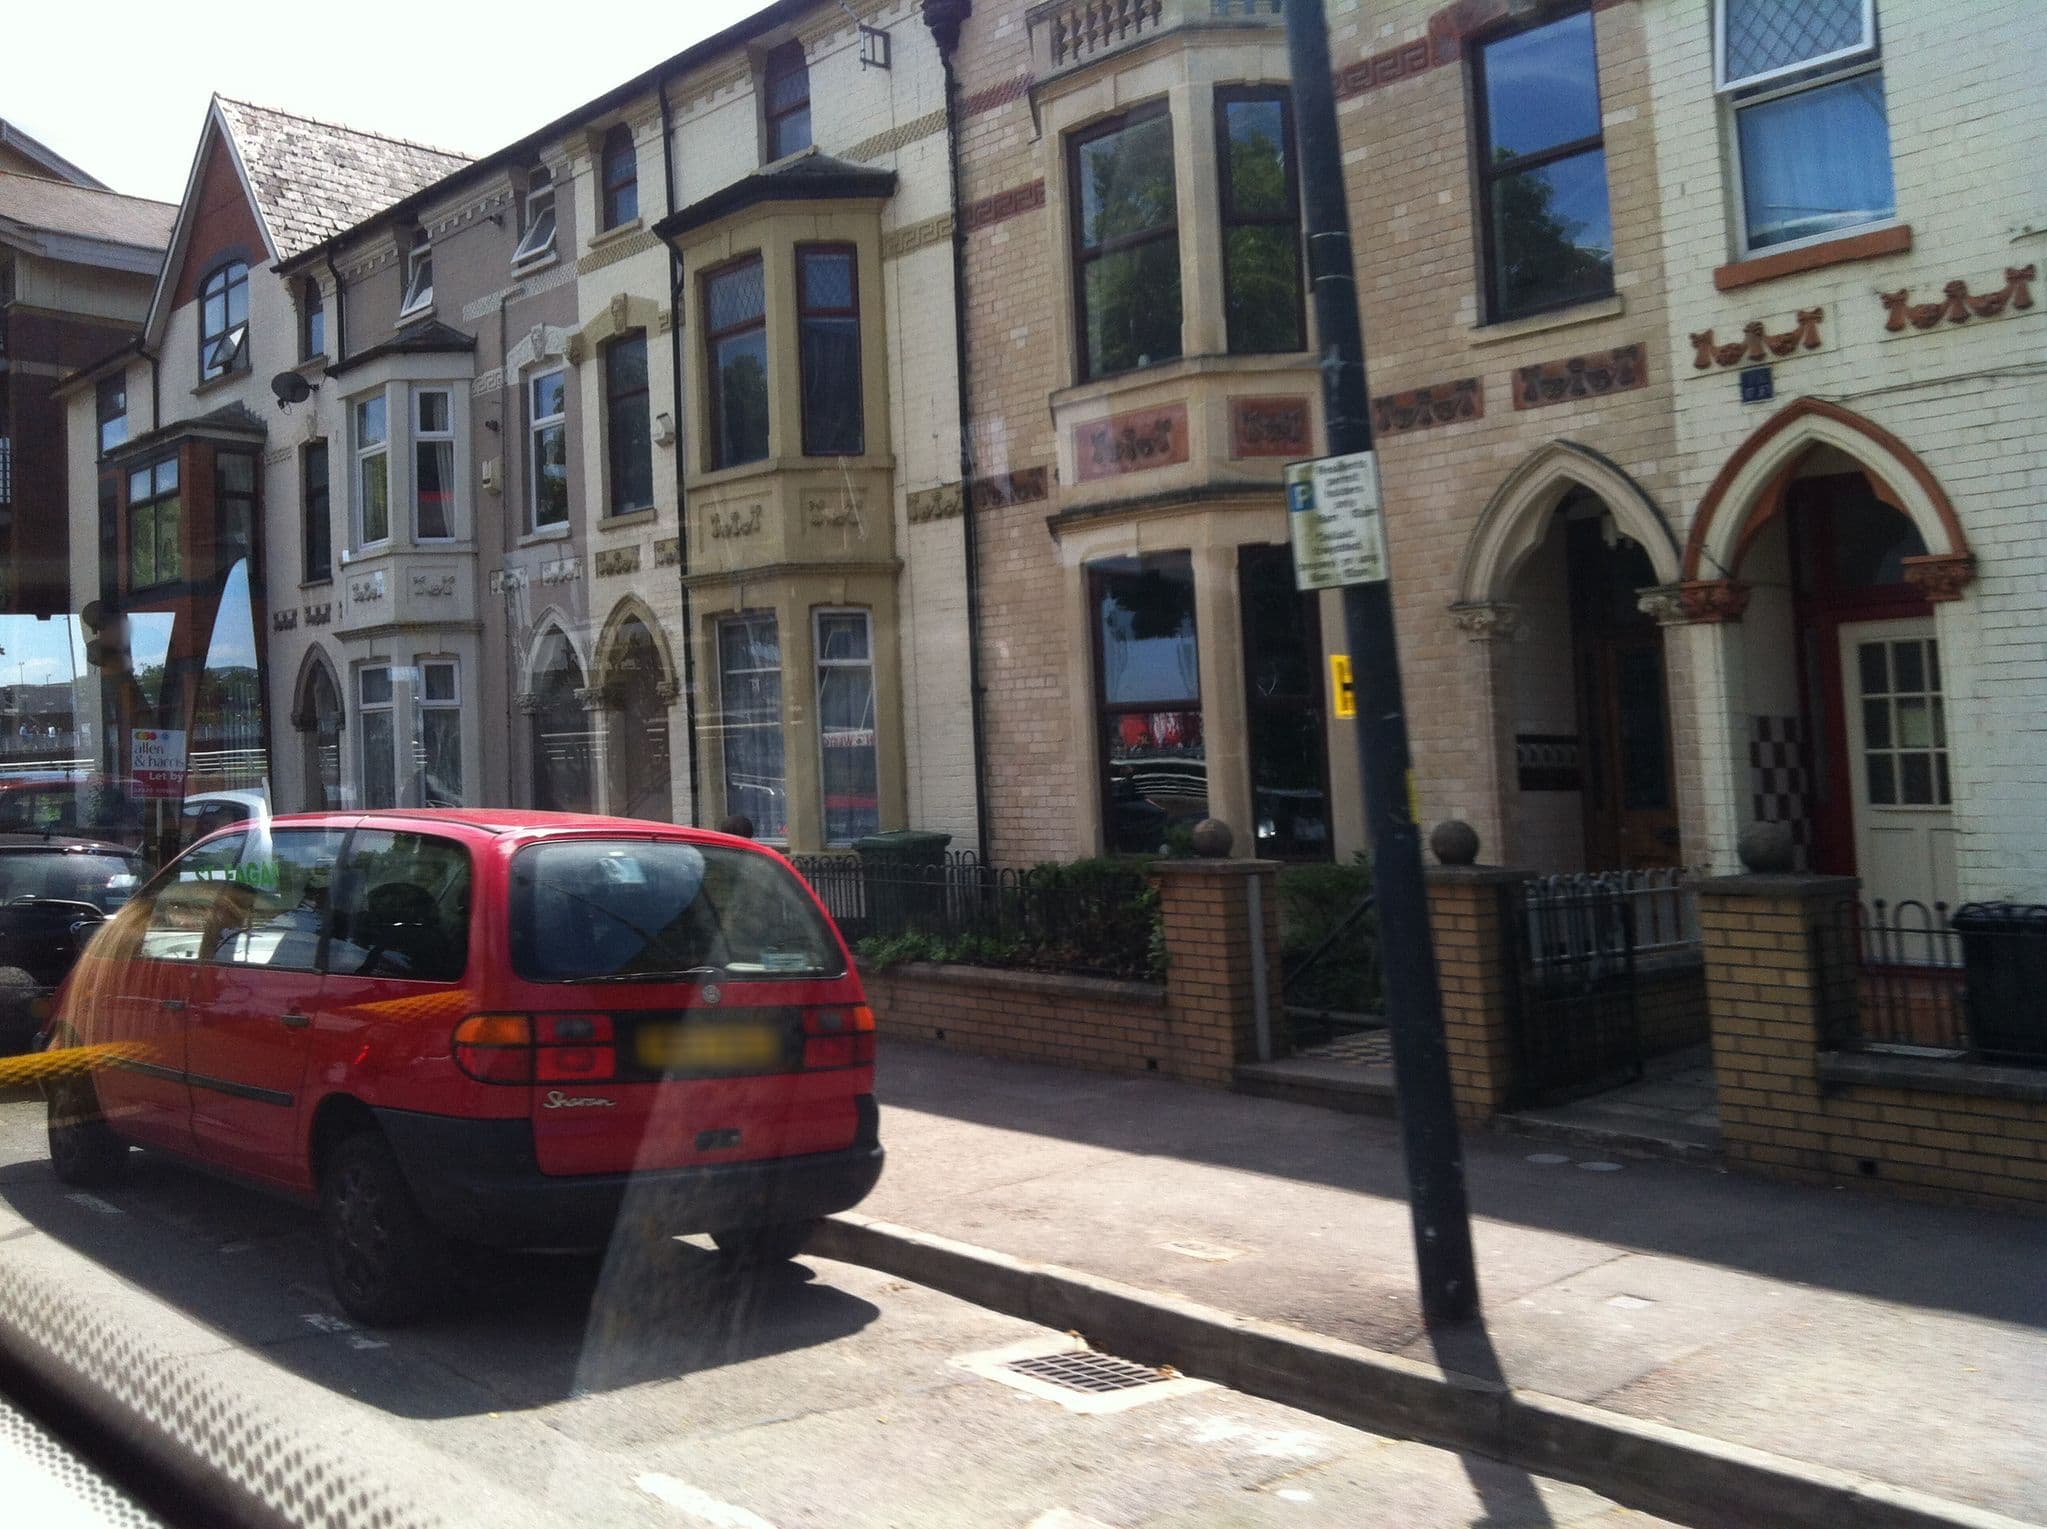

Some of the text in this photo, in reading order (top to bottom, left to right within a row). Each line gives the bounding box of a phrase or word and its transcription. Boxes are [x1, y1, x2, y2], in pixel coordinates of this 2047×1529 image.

[1294, 485, 1309, 510] P
[134, 755, 185, 767] & harris
[149, 771, 184, 783] Let by
